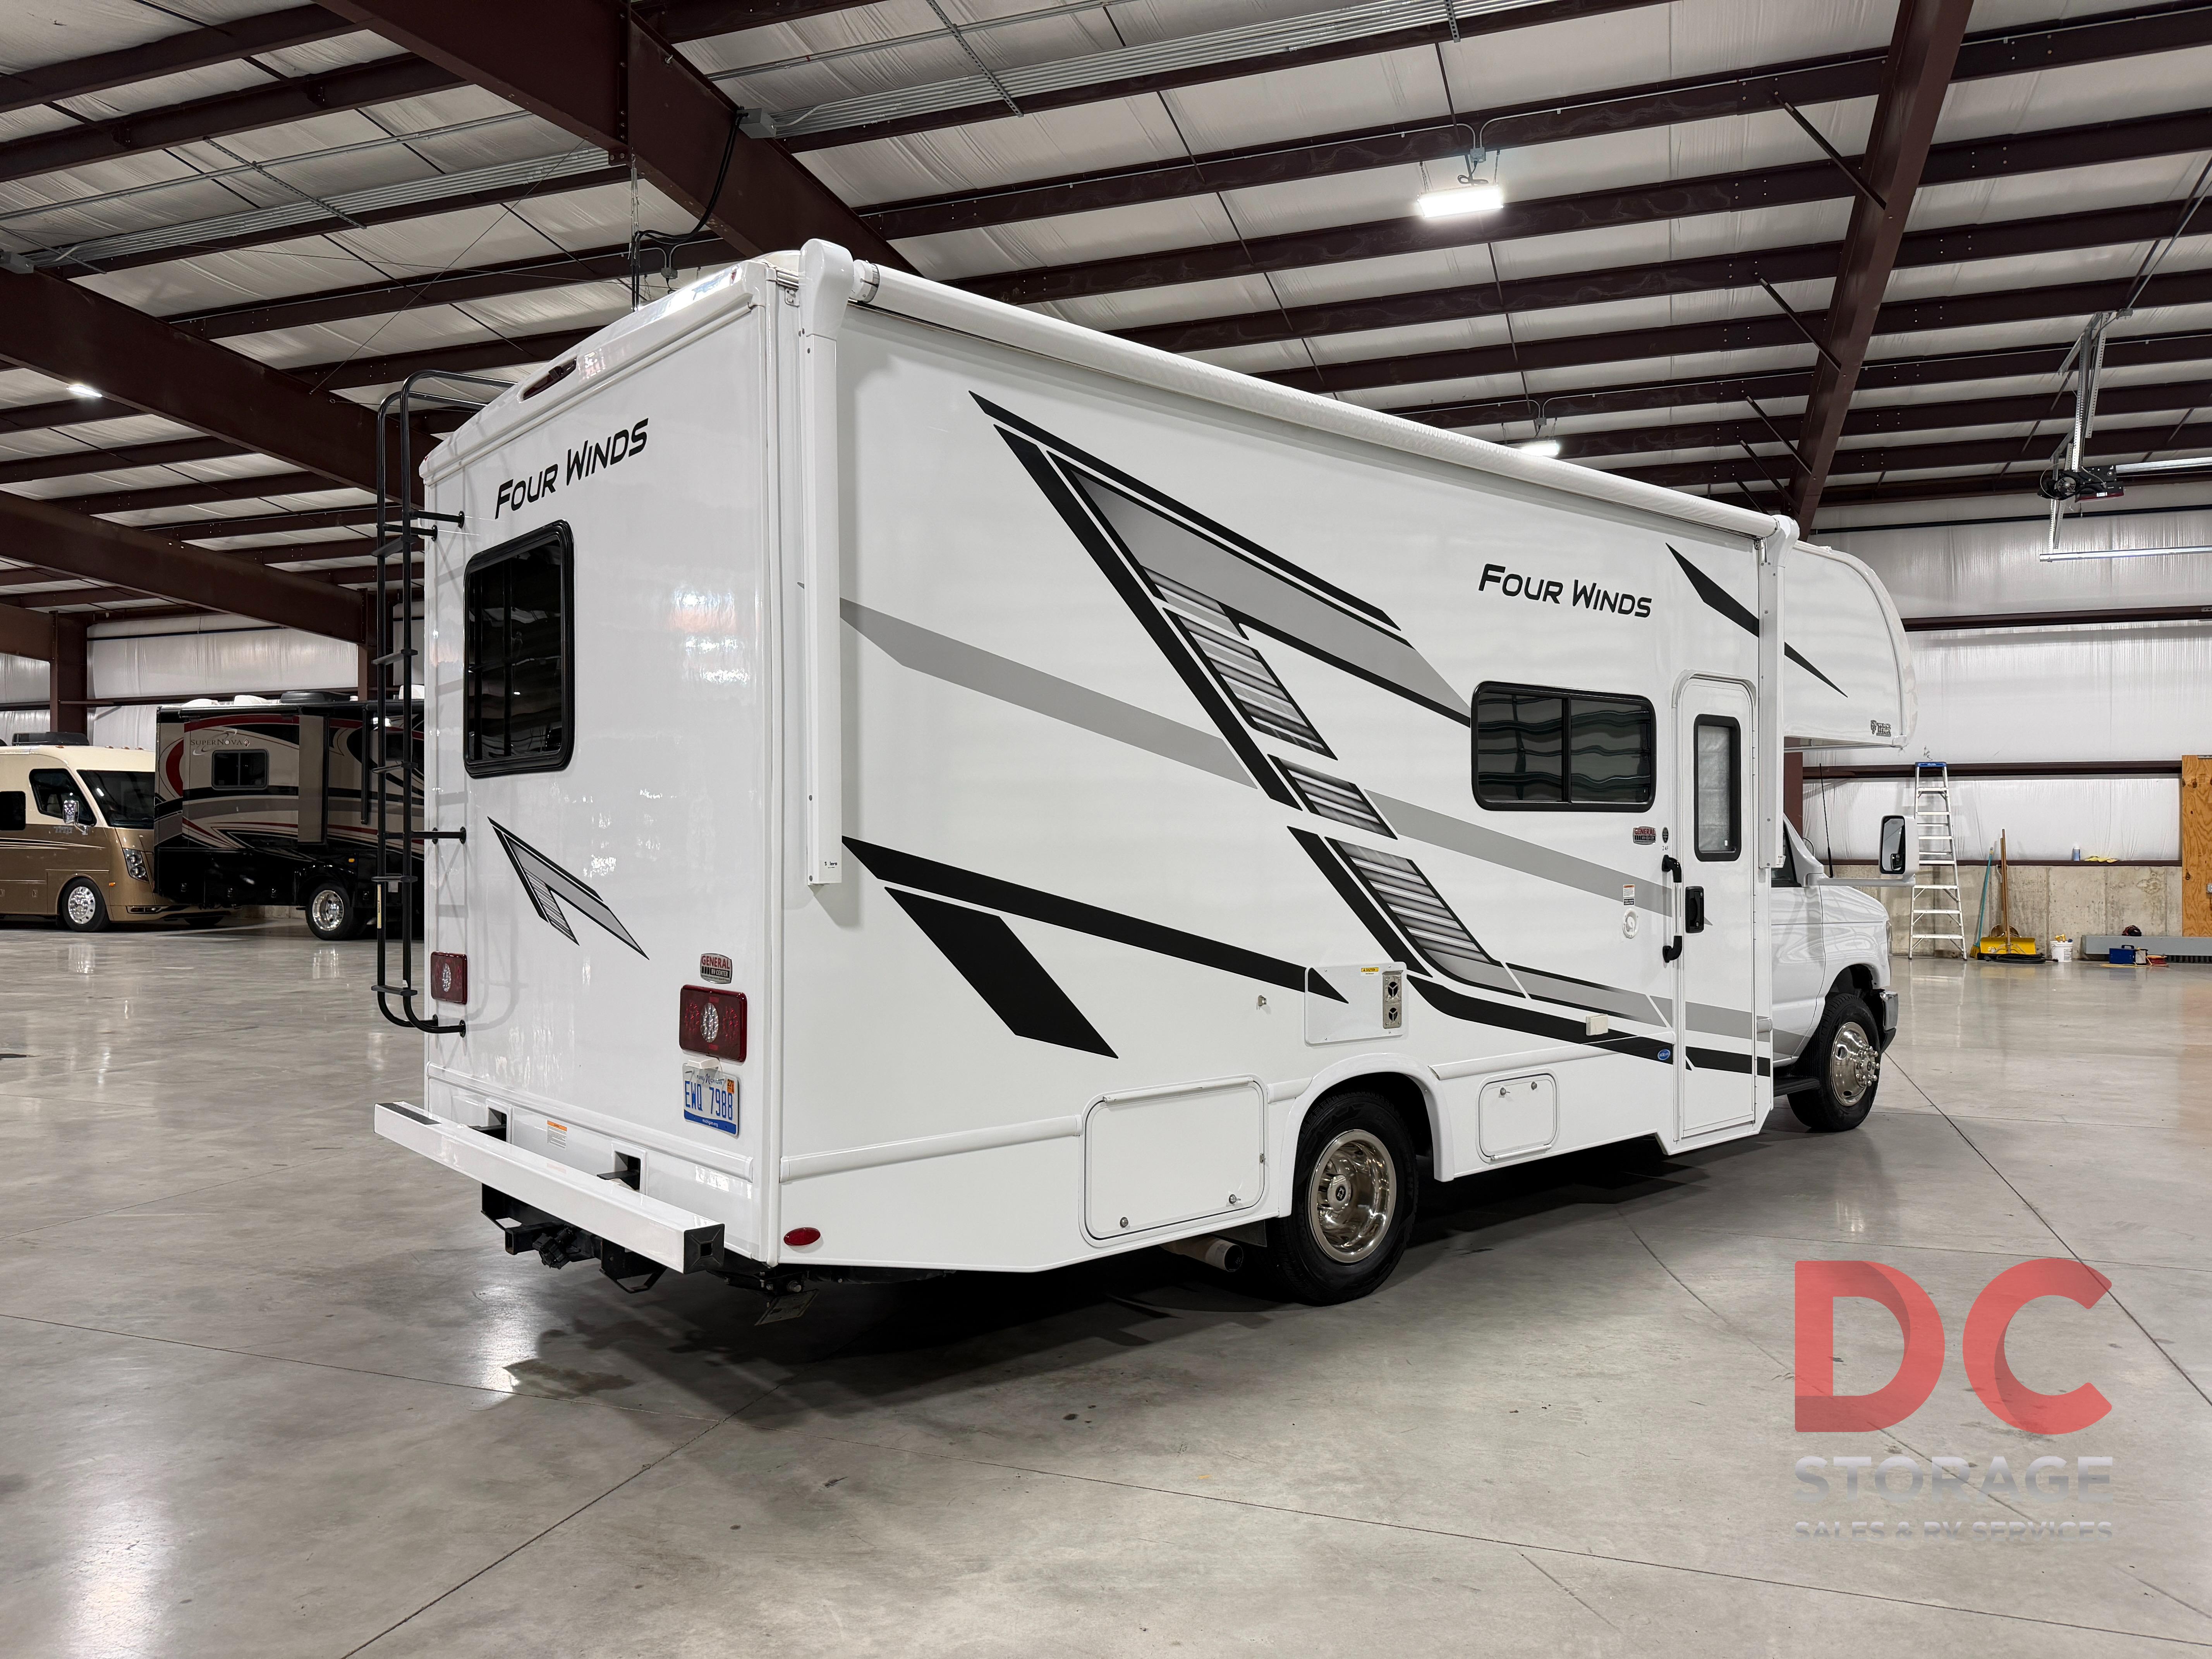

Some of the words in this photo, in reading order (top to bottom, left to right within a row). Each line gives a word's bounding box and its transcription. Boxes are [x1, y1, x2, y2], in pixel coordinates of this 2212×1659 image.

[702, 955, 730, 969] GENERAL
[685, 1080, 703, 1111] EWQ
[709, 1087, 733, 1121] 7988
